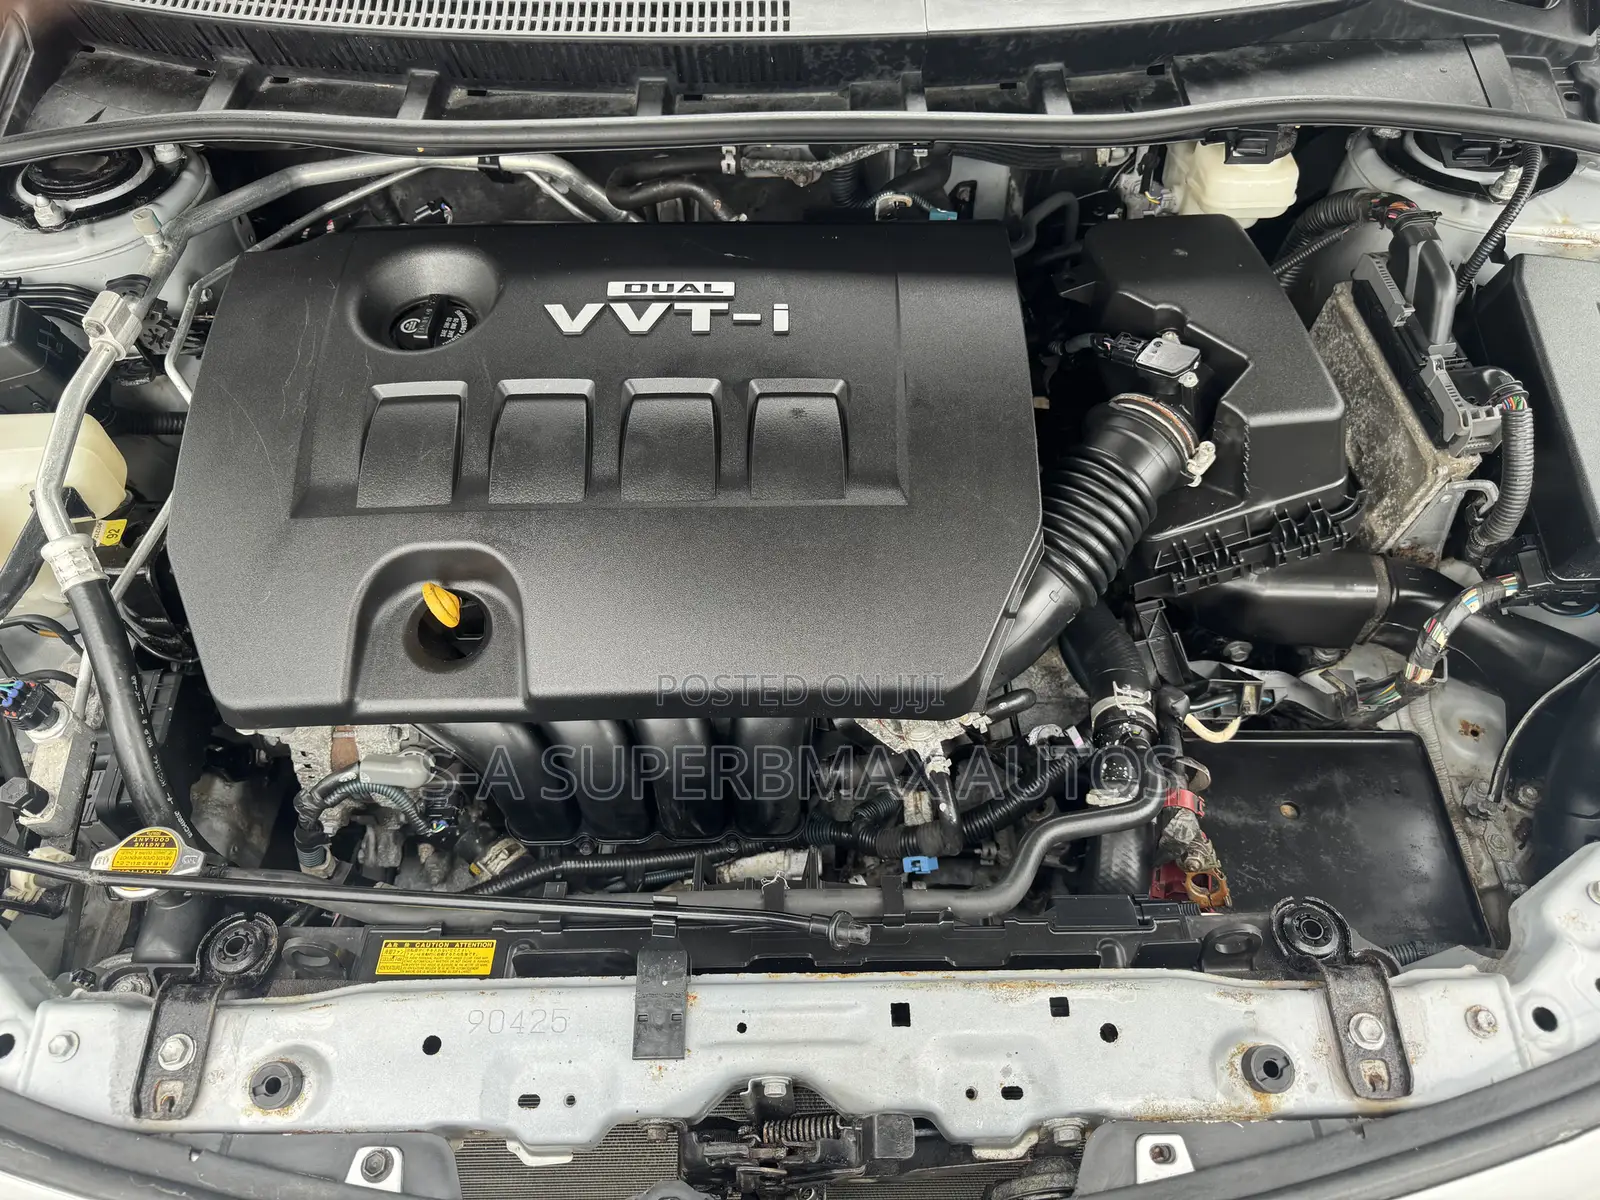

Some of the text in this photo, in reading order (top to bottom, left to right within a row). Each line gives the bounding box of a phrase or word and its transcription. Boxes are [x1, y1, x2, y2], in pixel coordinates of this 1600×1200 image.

[624, 283, 724, 294] DUAL
[543, 302, 790, 336] VVT-i
[106, 528, 121, 539] 92
[468, 1008, 569, 1034] 90425
